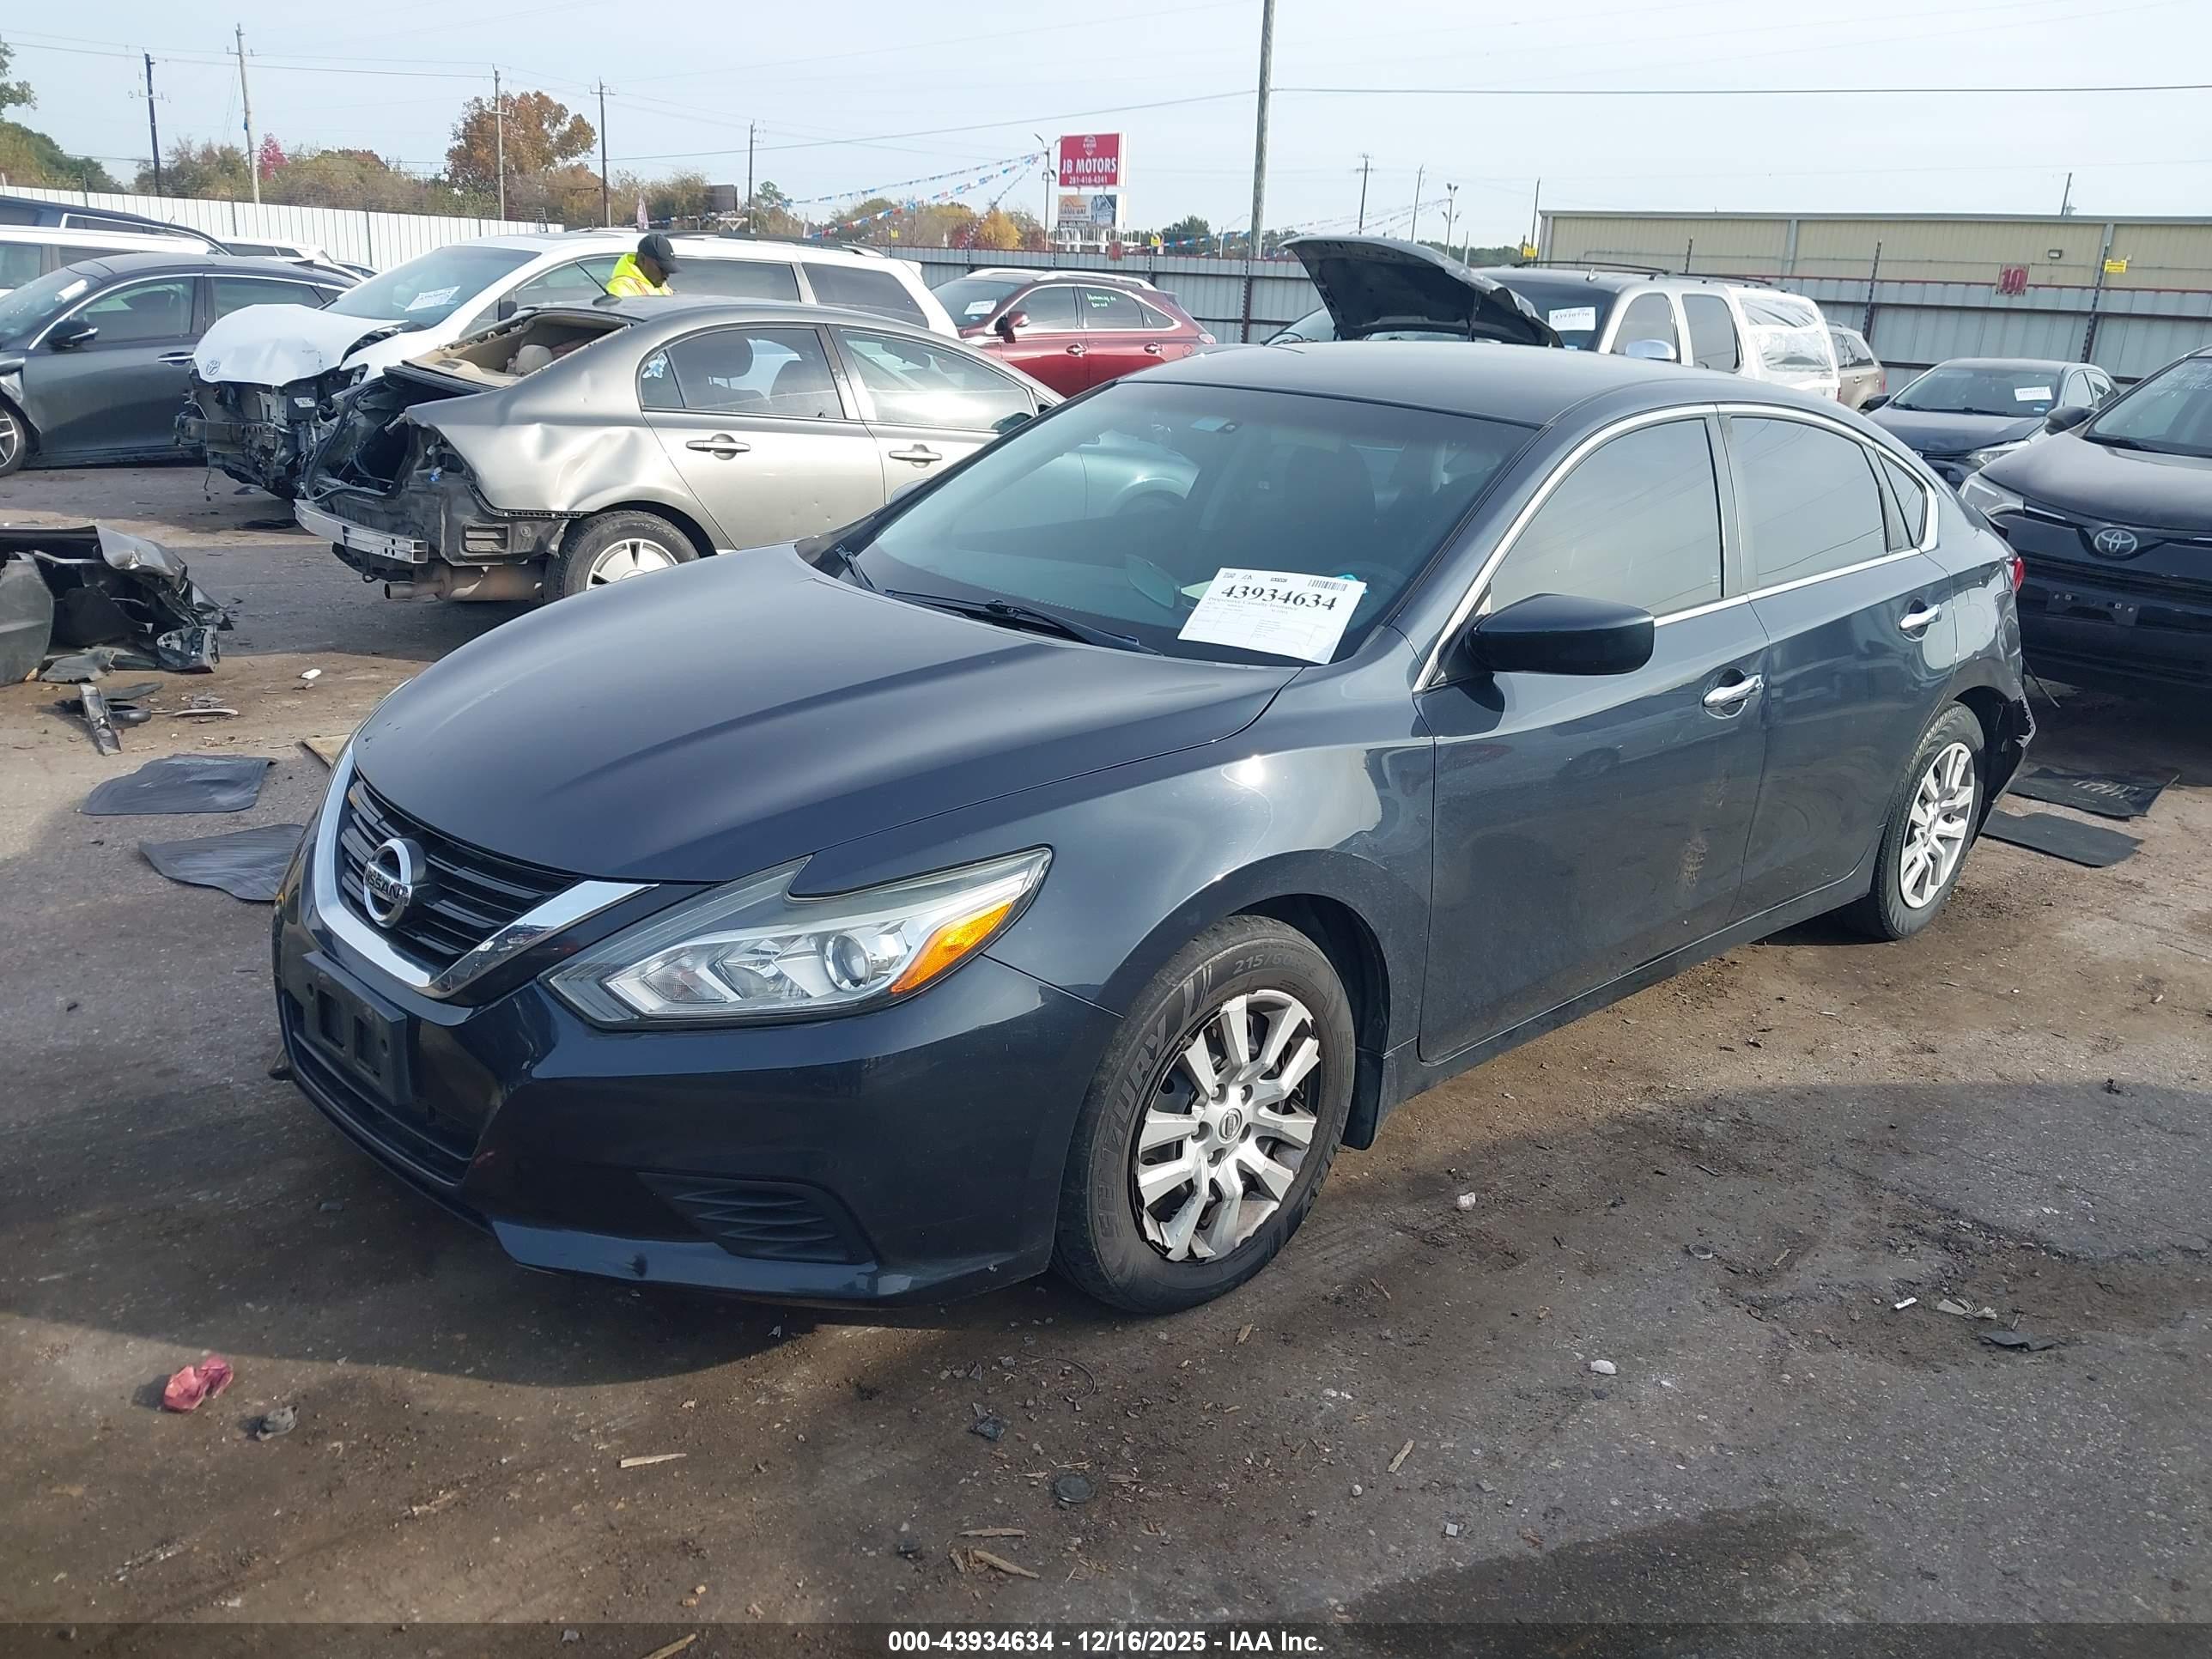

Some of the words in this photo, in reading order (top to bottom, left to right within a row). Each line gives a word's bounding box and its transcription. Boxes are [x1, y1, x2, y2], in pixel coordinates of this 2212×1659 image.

[1061, 158, 1073, 174] JB
[1075, 156, 1117, 173] MOTORS
[1221, 584, 1337, 611] 43934634
[1098, 1014, 1167, 1239] SENTURY
